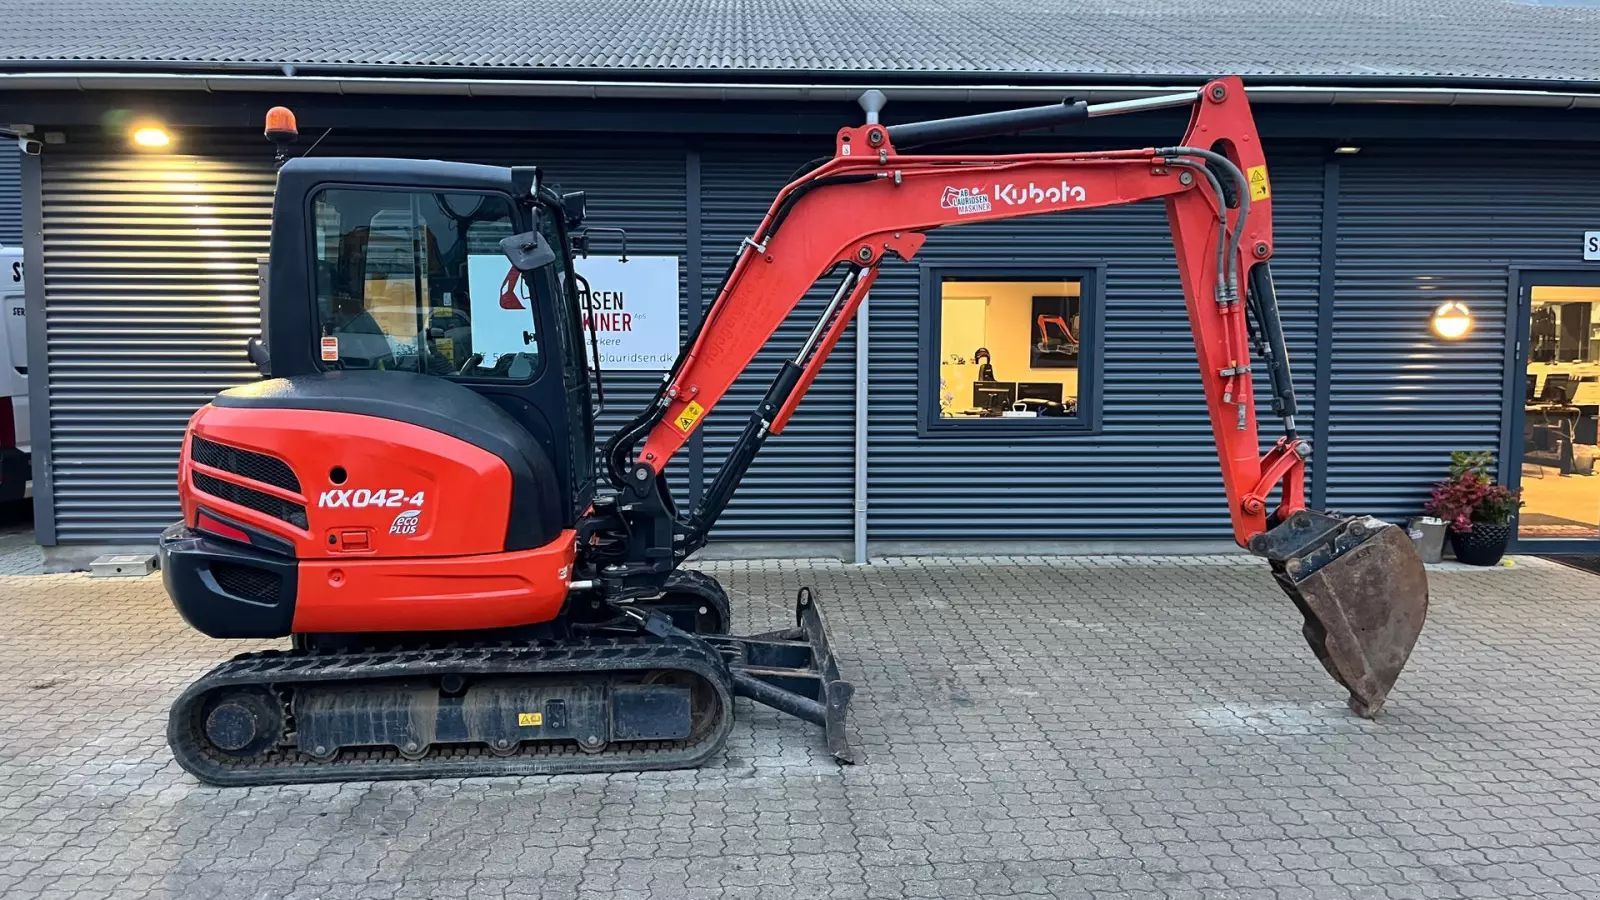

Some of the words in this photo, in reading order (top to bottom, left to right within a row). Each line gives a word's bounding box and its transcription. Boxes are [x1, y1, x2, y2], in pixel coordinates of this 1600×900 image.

[960, 187, 969, 198] AB
[994, 181, 1086, 205] Kubota
[953, 195, 988, 207] LAURIDSEN
[958, 202, 991, 214] MASKINER
[13, 261, 24, 282] S
[318, 489, 425, 508] KX042-4
[397, 517, 419, 526] eco
[389, 525, 417, 534] PLUS
